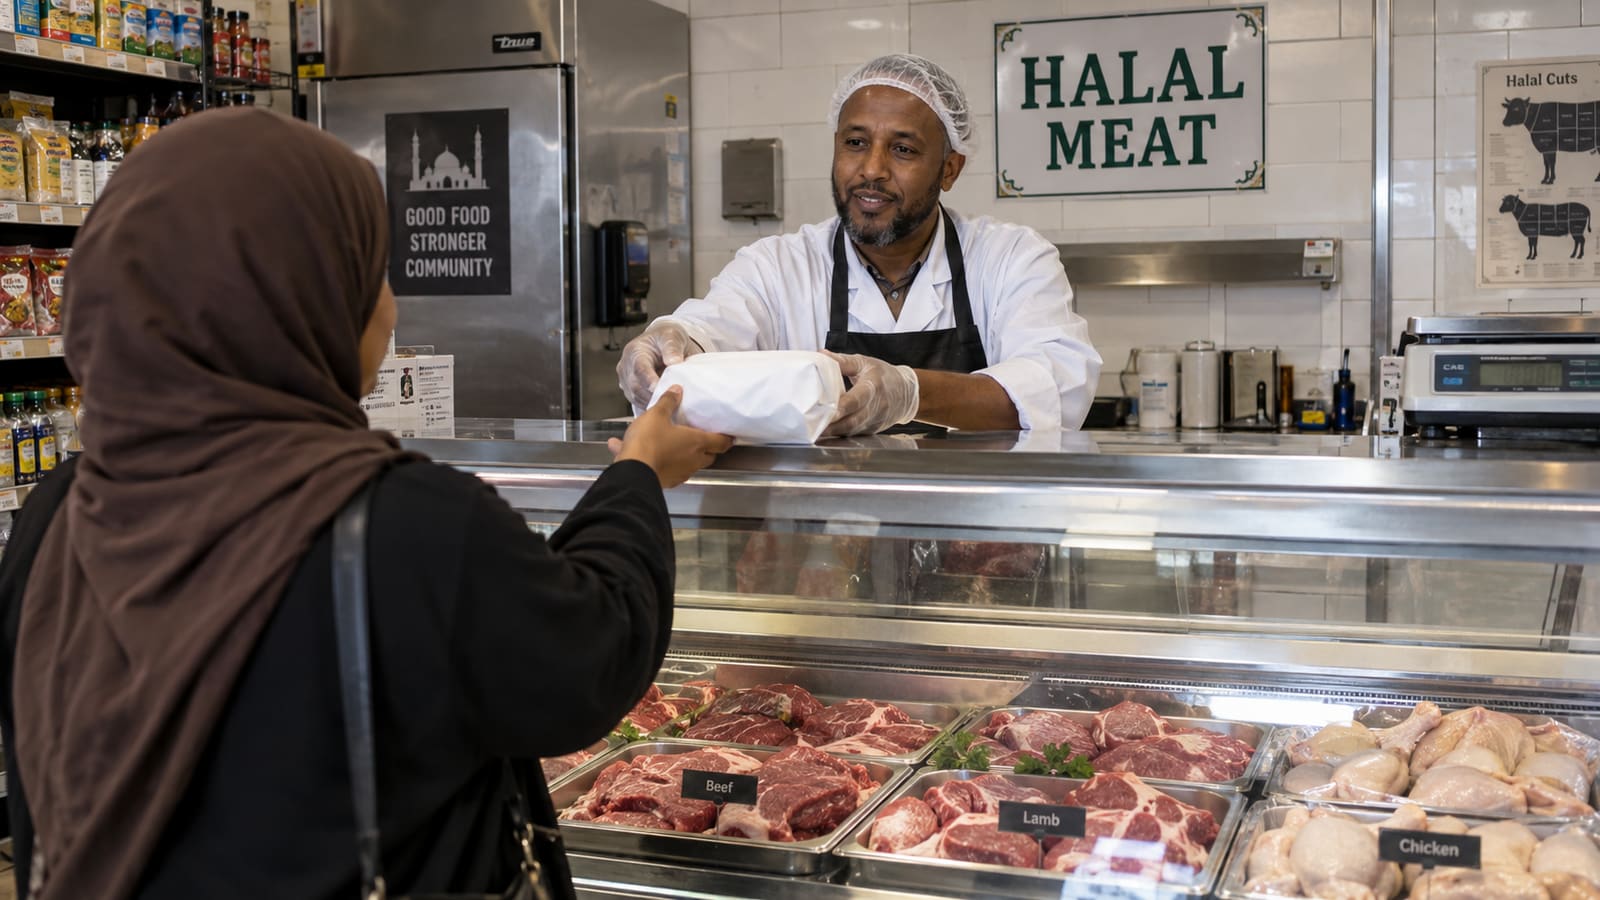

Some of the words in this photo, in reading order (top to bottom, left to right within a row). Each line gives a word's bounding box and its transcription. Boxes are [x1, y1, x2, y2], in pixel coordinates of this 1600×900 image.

[1020, 44, 1245, 110] HALAL
[1506, 73, 1542, 88] Halal
[1546, 72, 1579, 86] Cuts
[1046, 113, 1217, 171] MEAT
[405, 206, 446, 227] GOOD
[451, 205, 490, 226] FOOD
[410, 231, 487, 252] STRONGER
[405, 257, 493, 278] COMMUNITY
[705, 779, 734, 794] Beef
[1023, 810, 1061, 828] Lamb
[1399, 837, 1460, 858] Chicken
